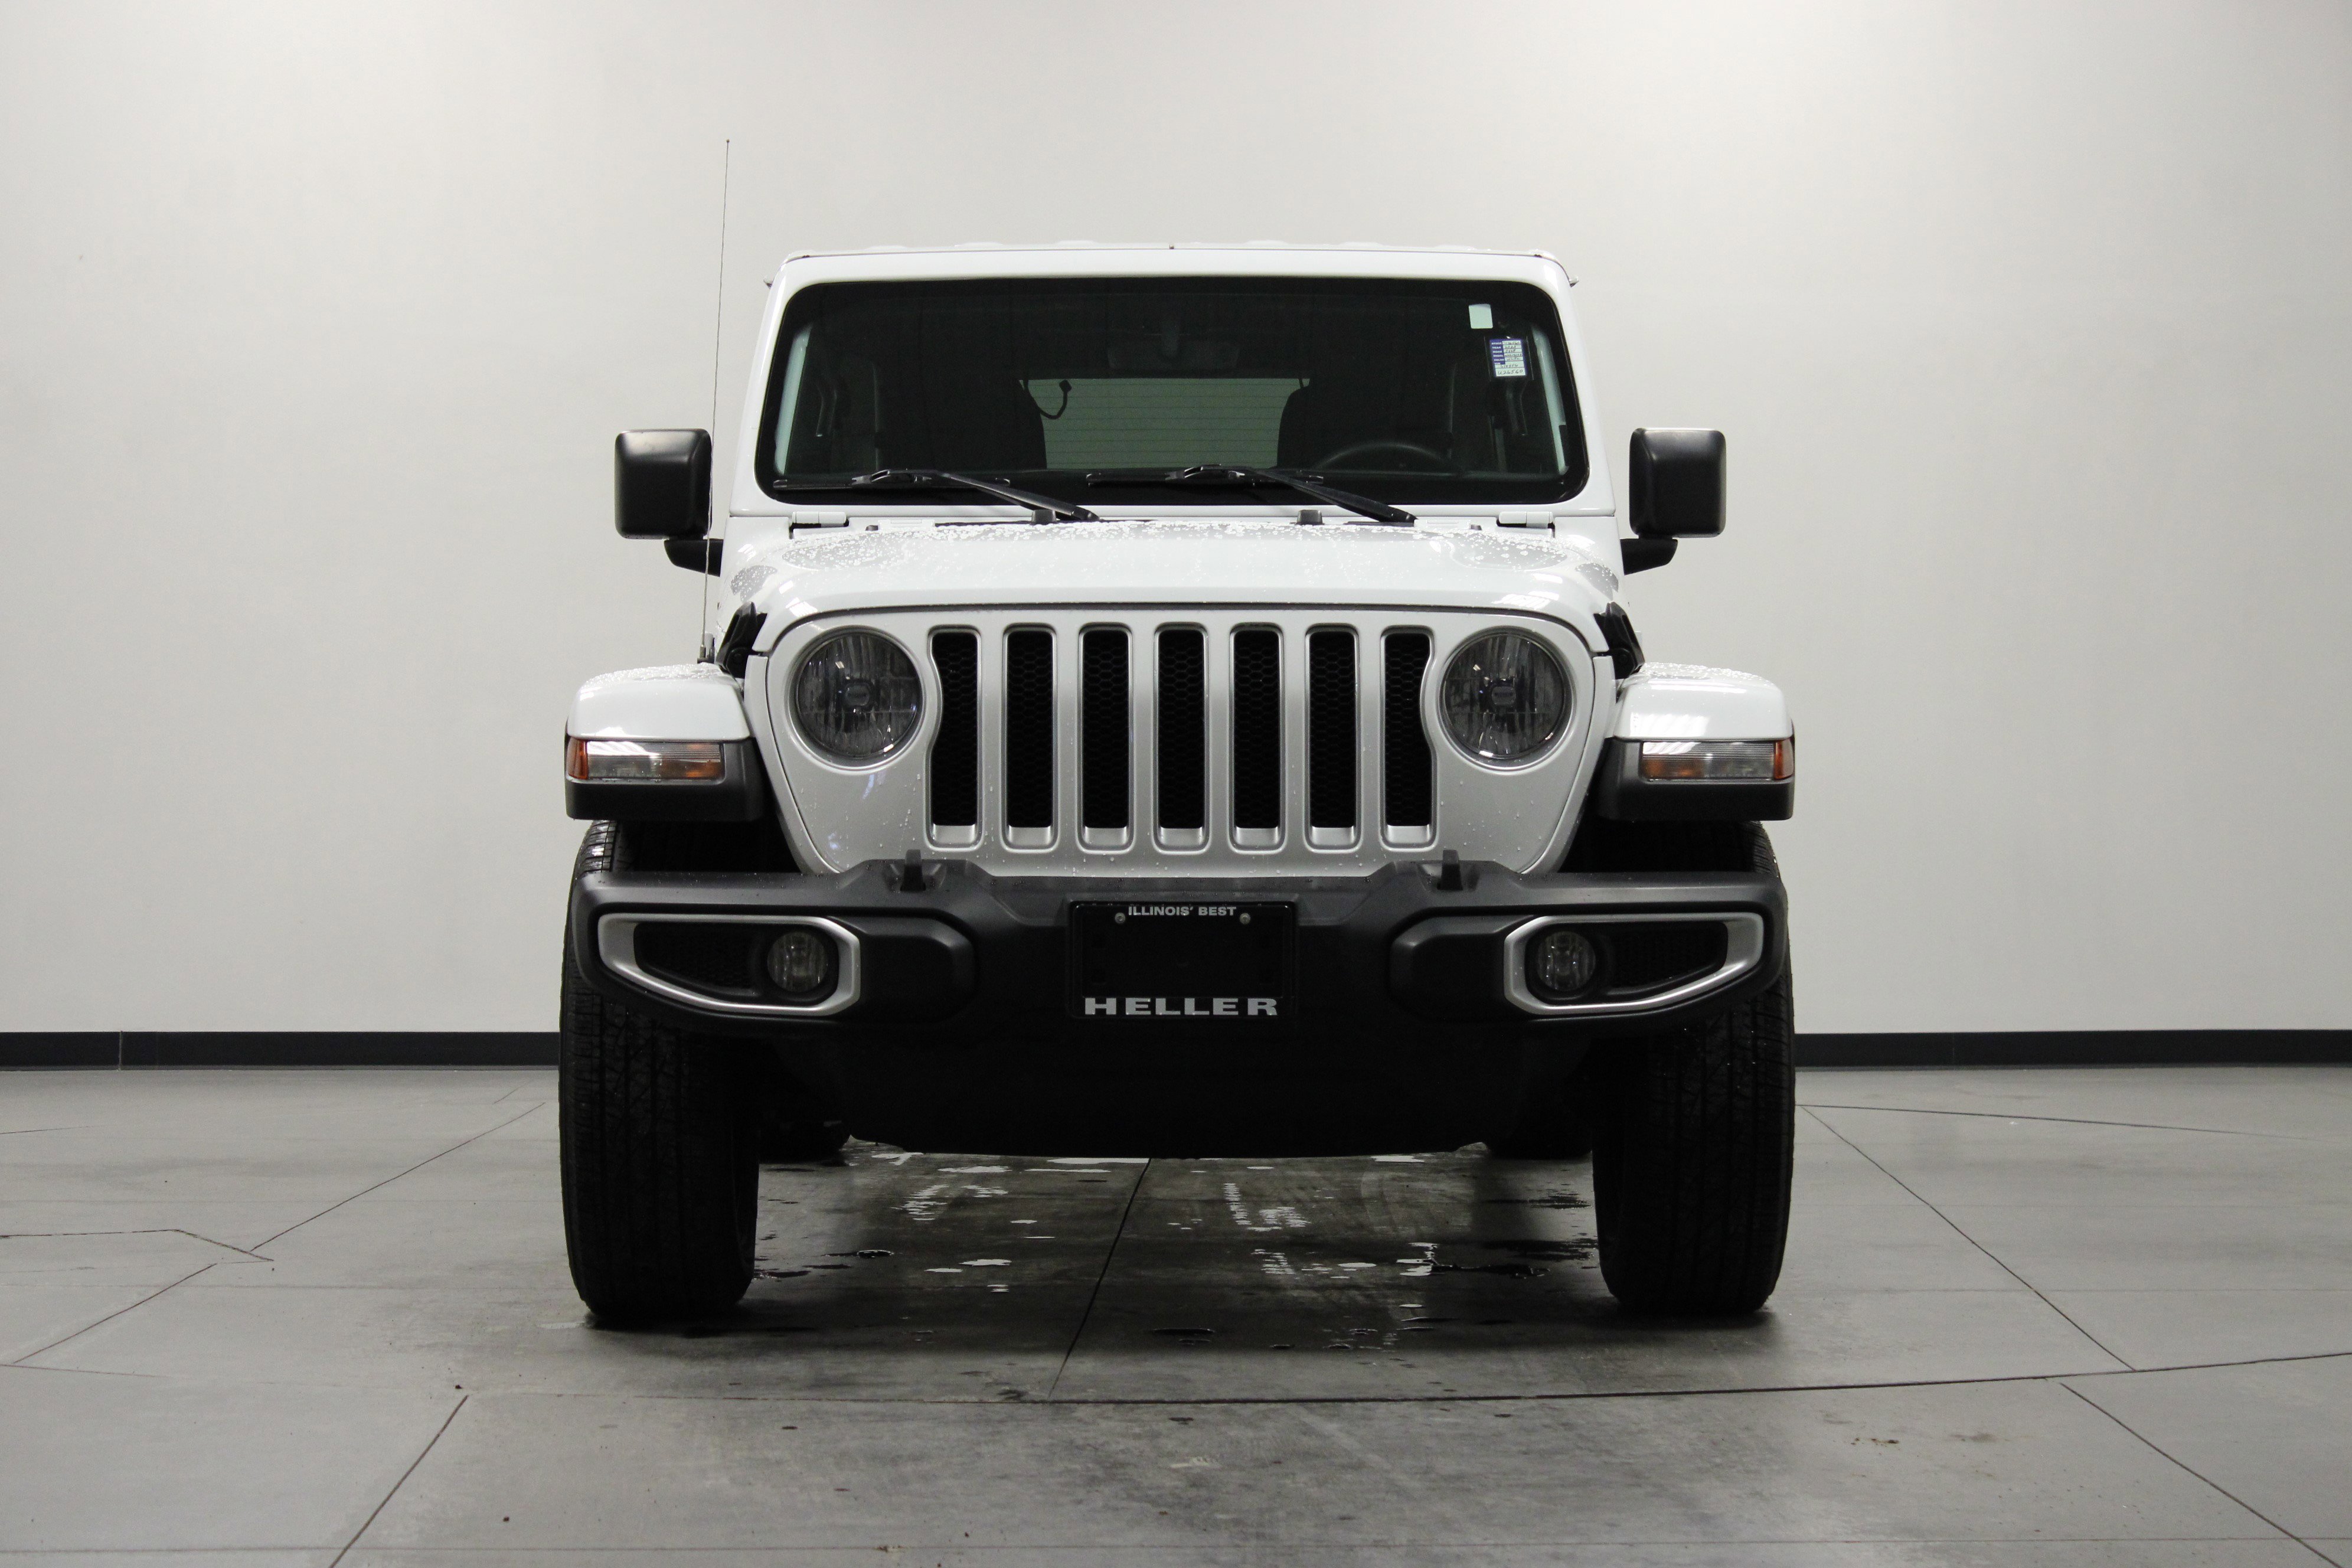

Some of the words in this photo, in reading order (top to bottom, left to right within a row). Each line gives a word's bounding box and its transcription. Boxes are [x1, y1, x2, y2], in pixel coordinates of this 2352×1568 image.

[1128, 906, 1194, 916] ILLINOIS'
[1198, 906, 1237, 916] BEST
[1084, 997, 1278, 1016] HELLER
